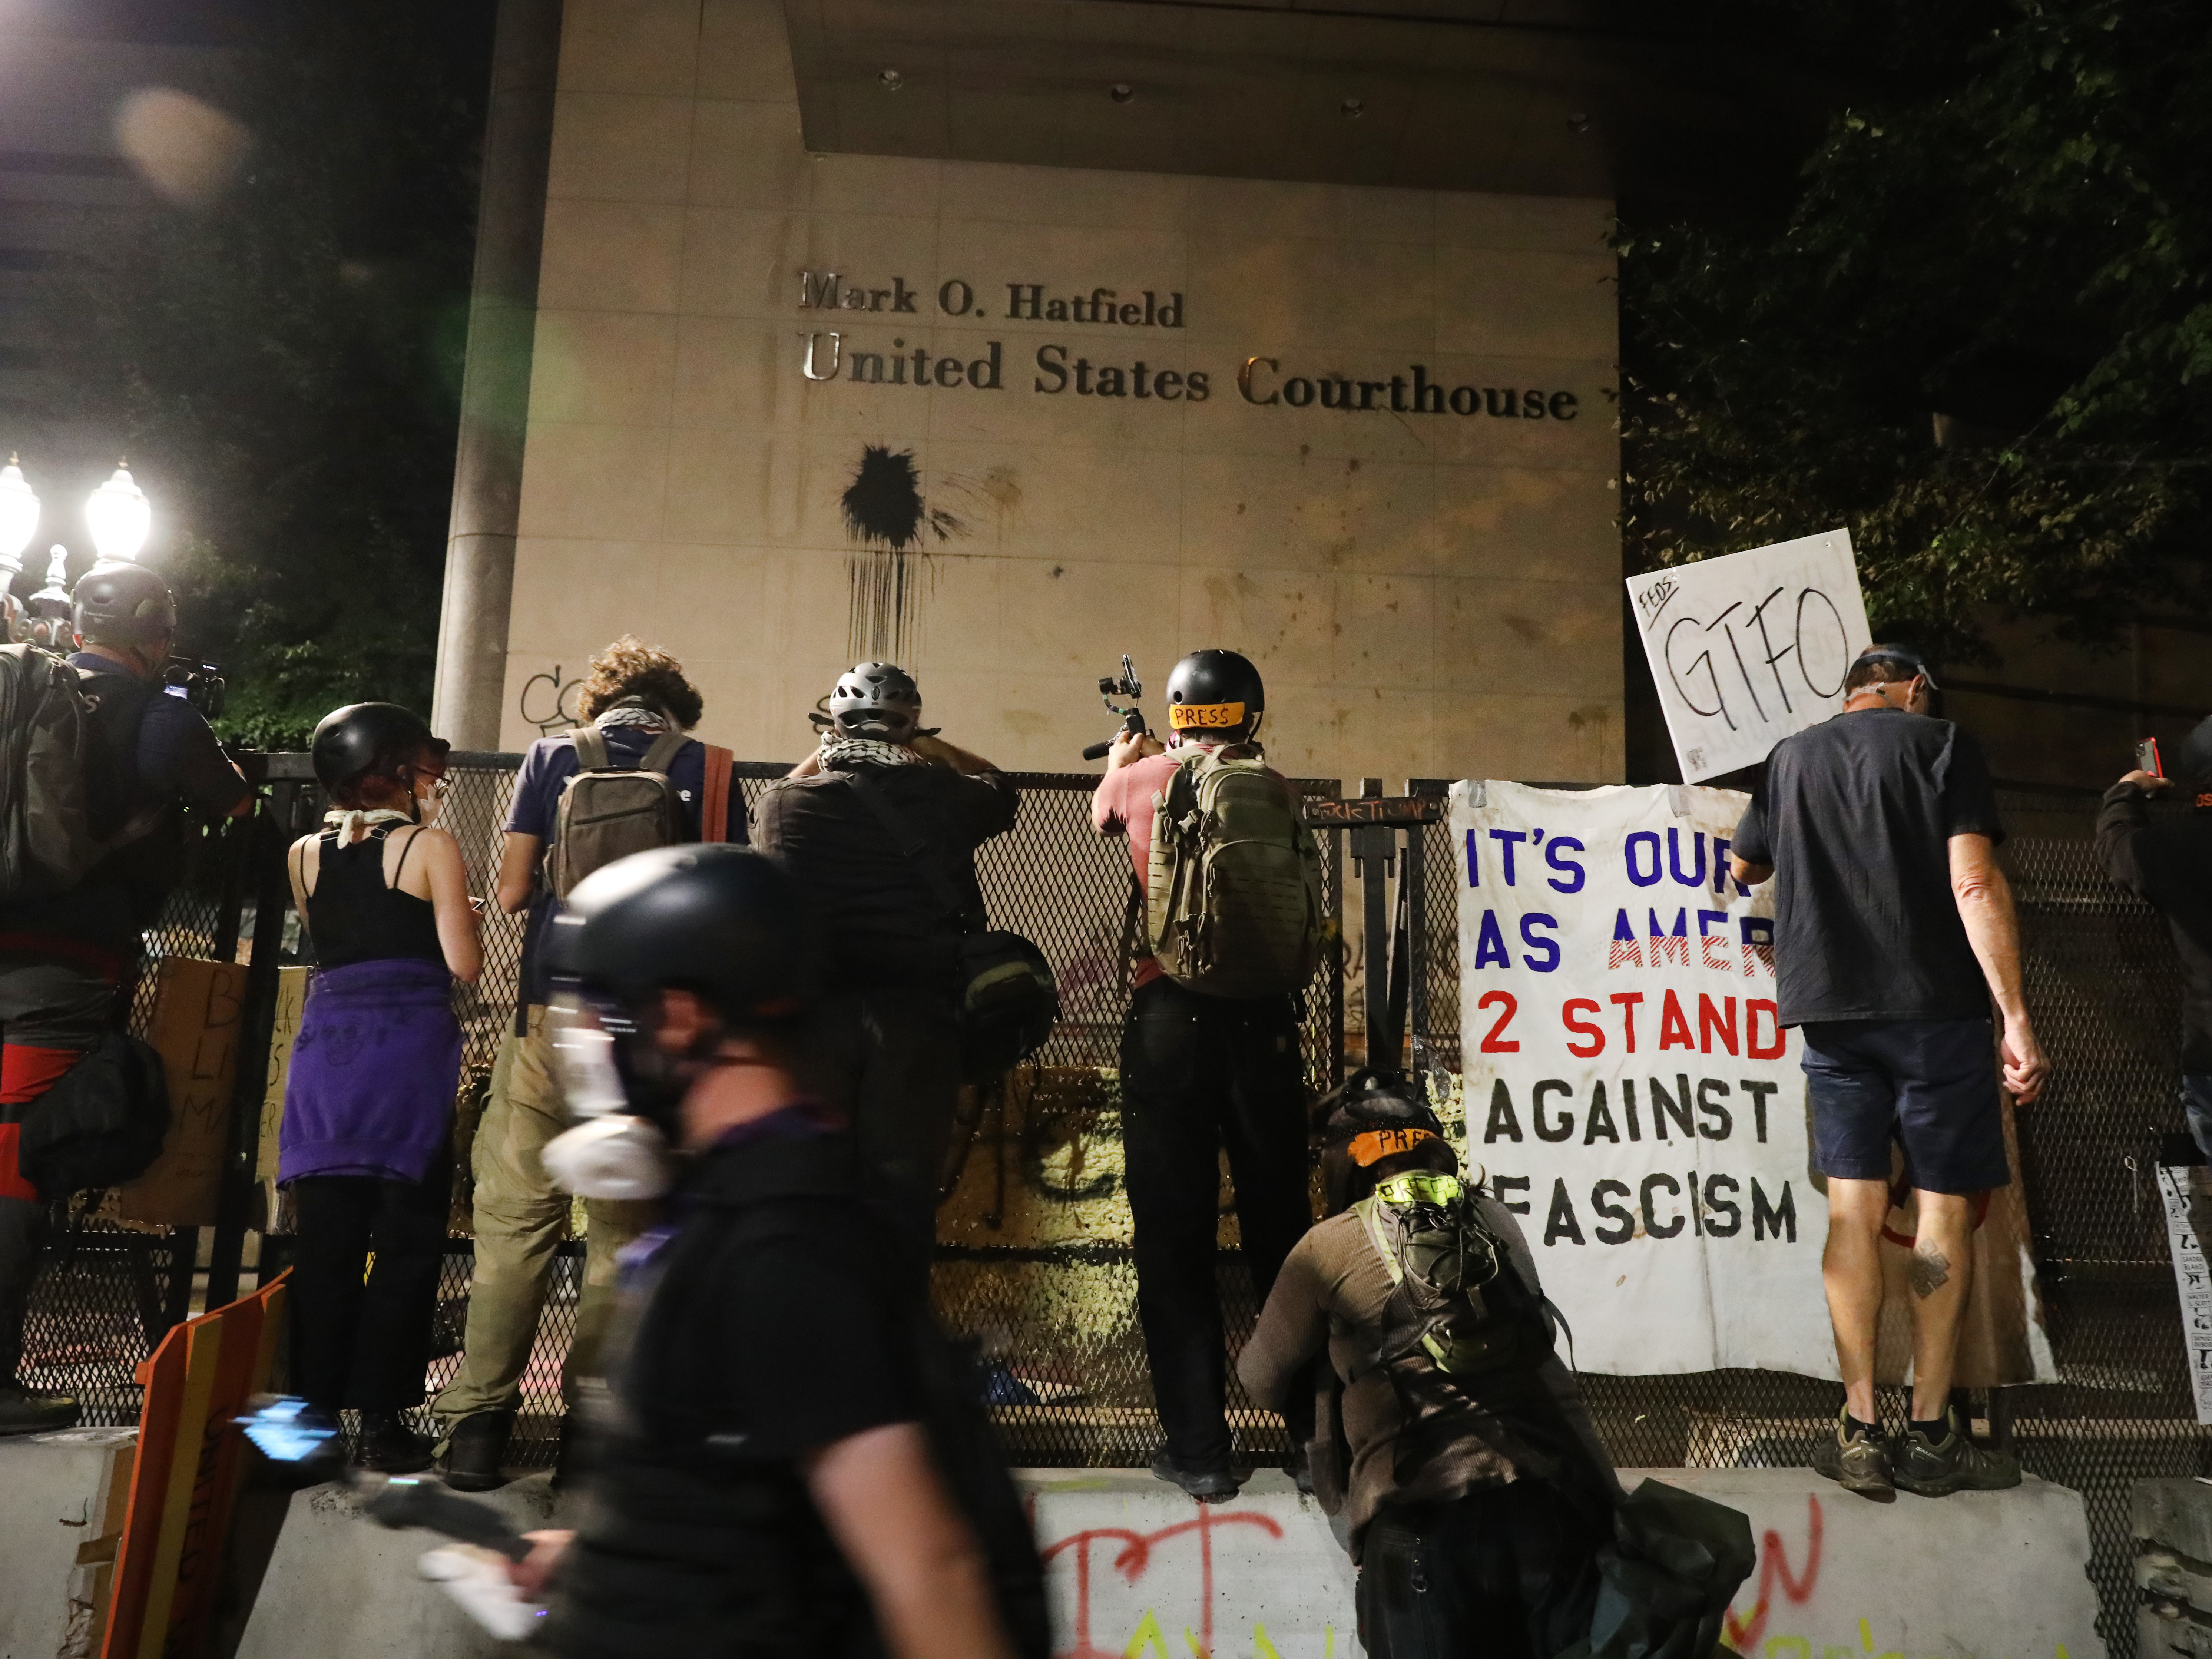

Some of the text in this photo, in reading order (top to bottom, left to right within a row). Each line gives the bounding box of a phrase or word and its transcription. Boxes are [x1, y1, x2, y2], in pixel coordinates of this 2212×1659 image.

[798, 272, 1185, 328] Mark O. Hatfield
[798, 331, 1579, 421] United States Courthouse
[1665, 587, 1848, 731] GTFO
[1175, 708, 1228, 725] PRESS
[1466, 828, 1585, 894] IT'S
[1474, 909, 1560, 972] AS
[1478, 989, 1786, 1060] 2 STAND
[1379, 1130, 1430, 1152] PRE
[1484, 1074, 1778, 1145] AGAINST
[1493, 1171, 1797, 1248] FASCISM
